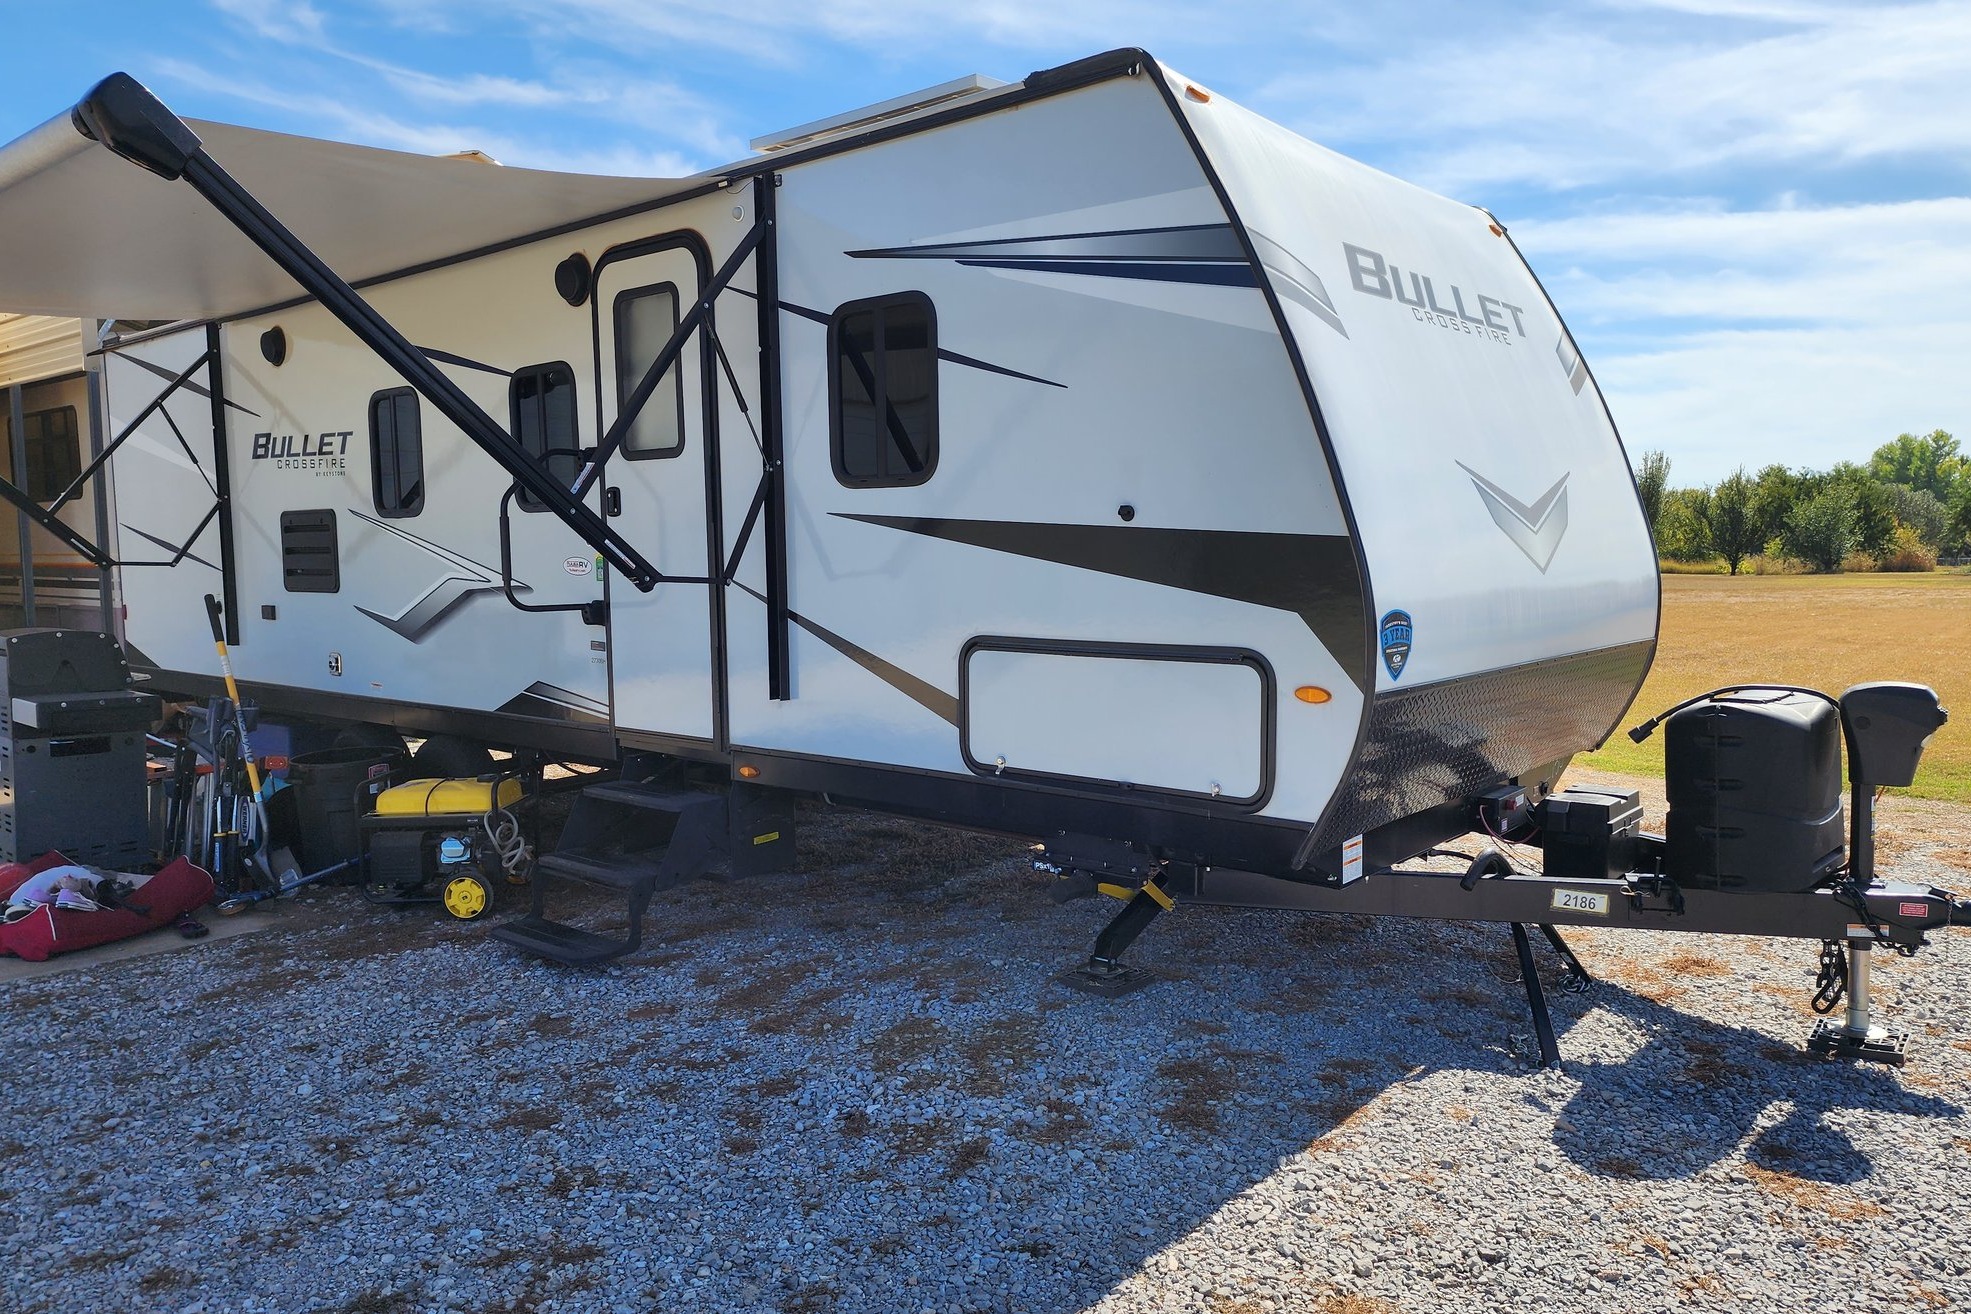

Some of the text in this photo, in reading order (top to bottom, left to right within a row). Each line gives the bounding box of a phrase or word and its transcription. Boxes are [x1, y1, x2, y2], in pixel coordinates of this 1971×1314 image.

[1343, 242, 1526, 338] BULLET
[252, 431, 354, 459] BULLET
[277, 459, 346, 469] CROSSFIRE
[1383, 628, 1409, 645] 3 YEAR
[1563, 893, 1596, 910] 2186
